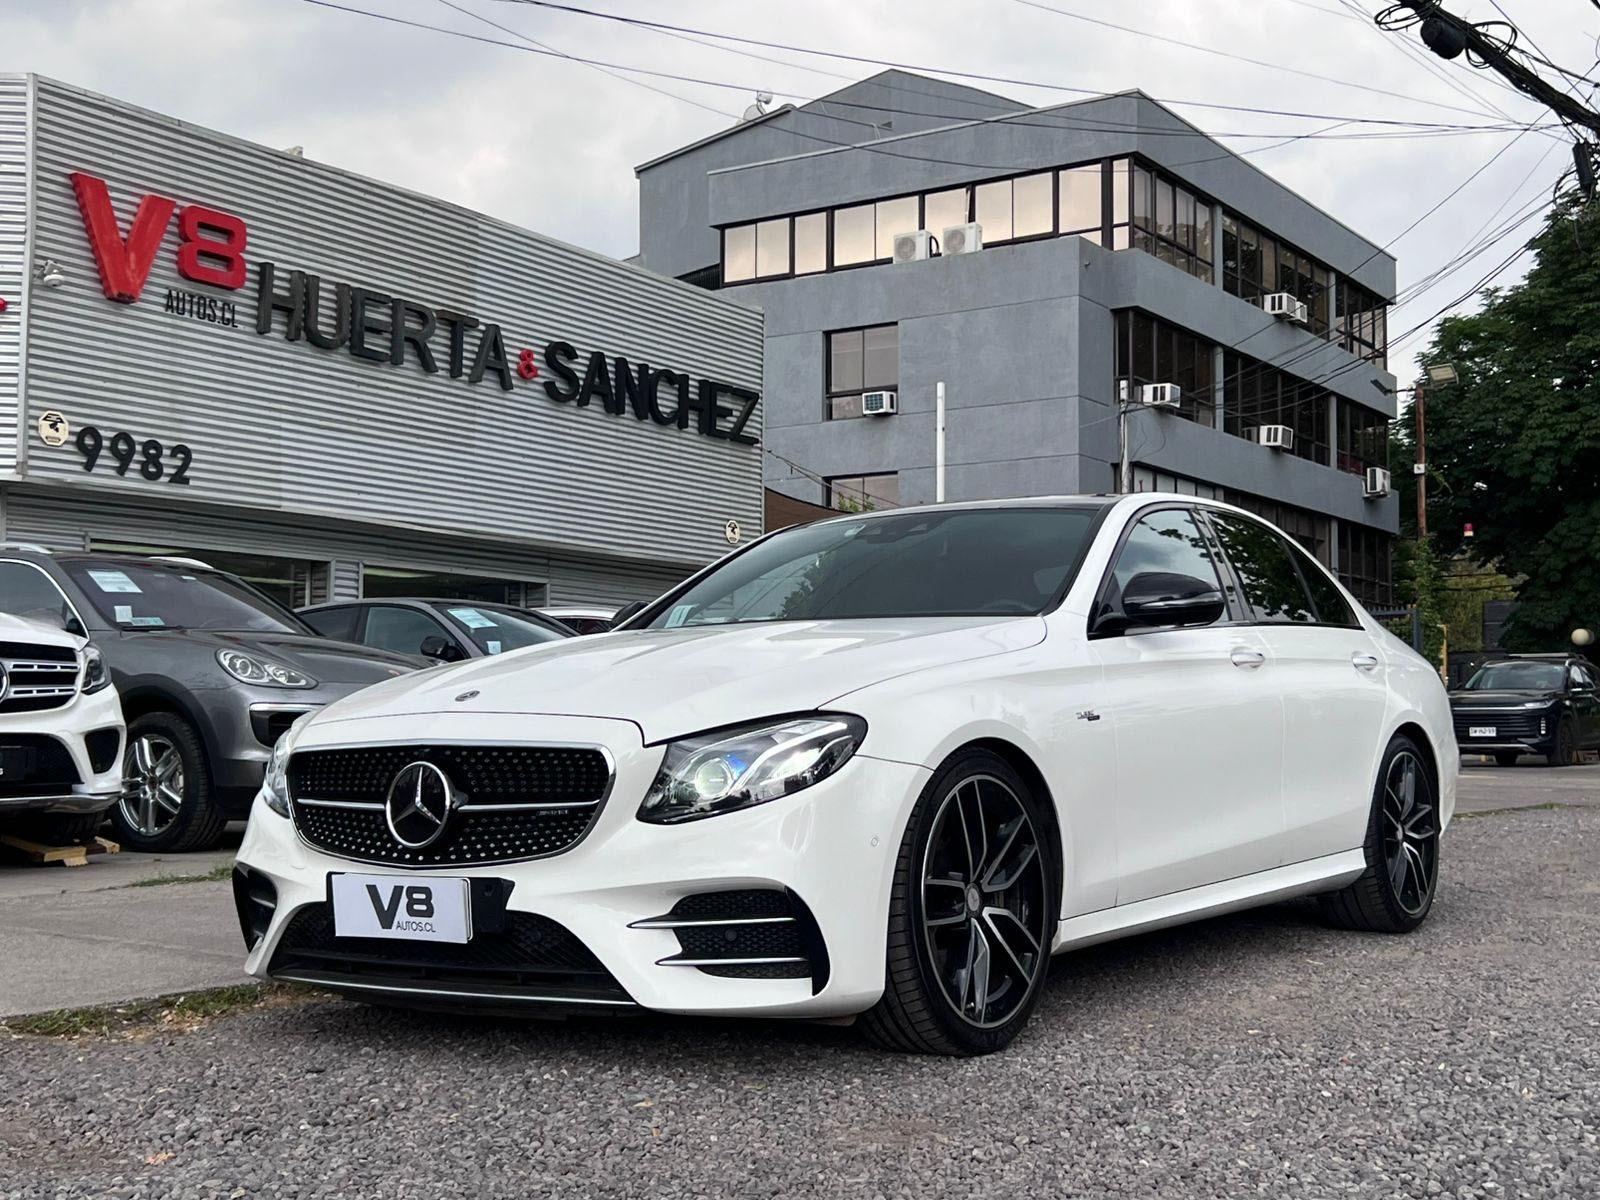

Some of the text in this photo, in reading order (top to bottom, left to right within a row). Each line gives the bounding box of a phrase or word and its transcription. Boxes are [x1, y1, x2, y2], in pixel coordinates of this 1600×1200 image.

[70, 172, 247, 302] V8
[164, 289, 239, 328] AUTOS.CL
[257, 261, 760, 445] HUERTA & SANCHEZ
[76, 426, 192, 485] 9982
[365, 884, 434, 930] V8
[396, 920, 436, 933] AUTOS.CL
